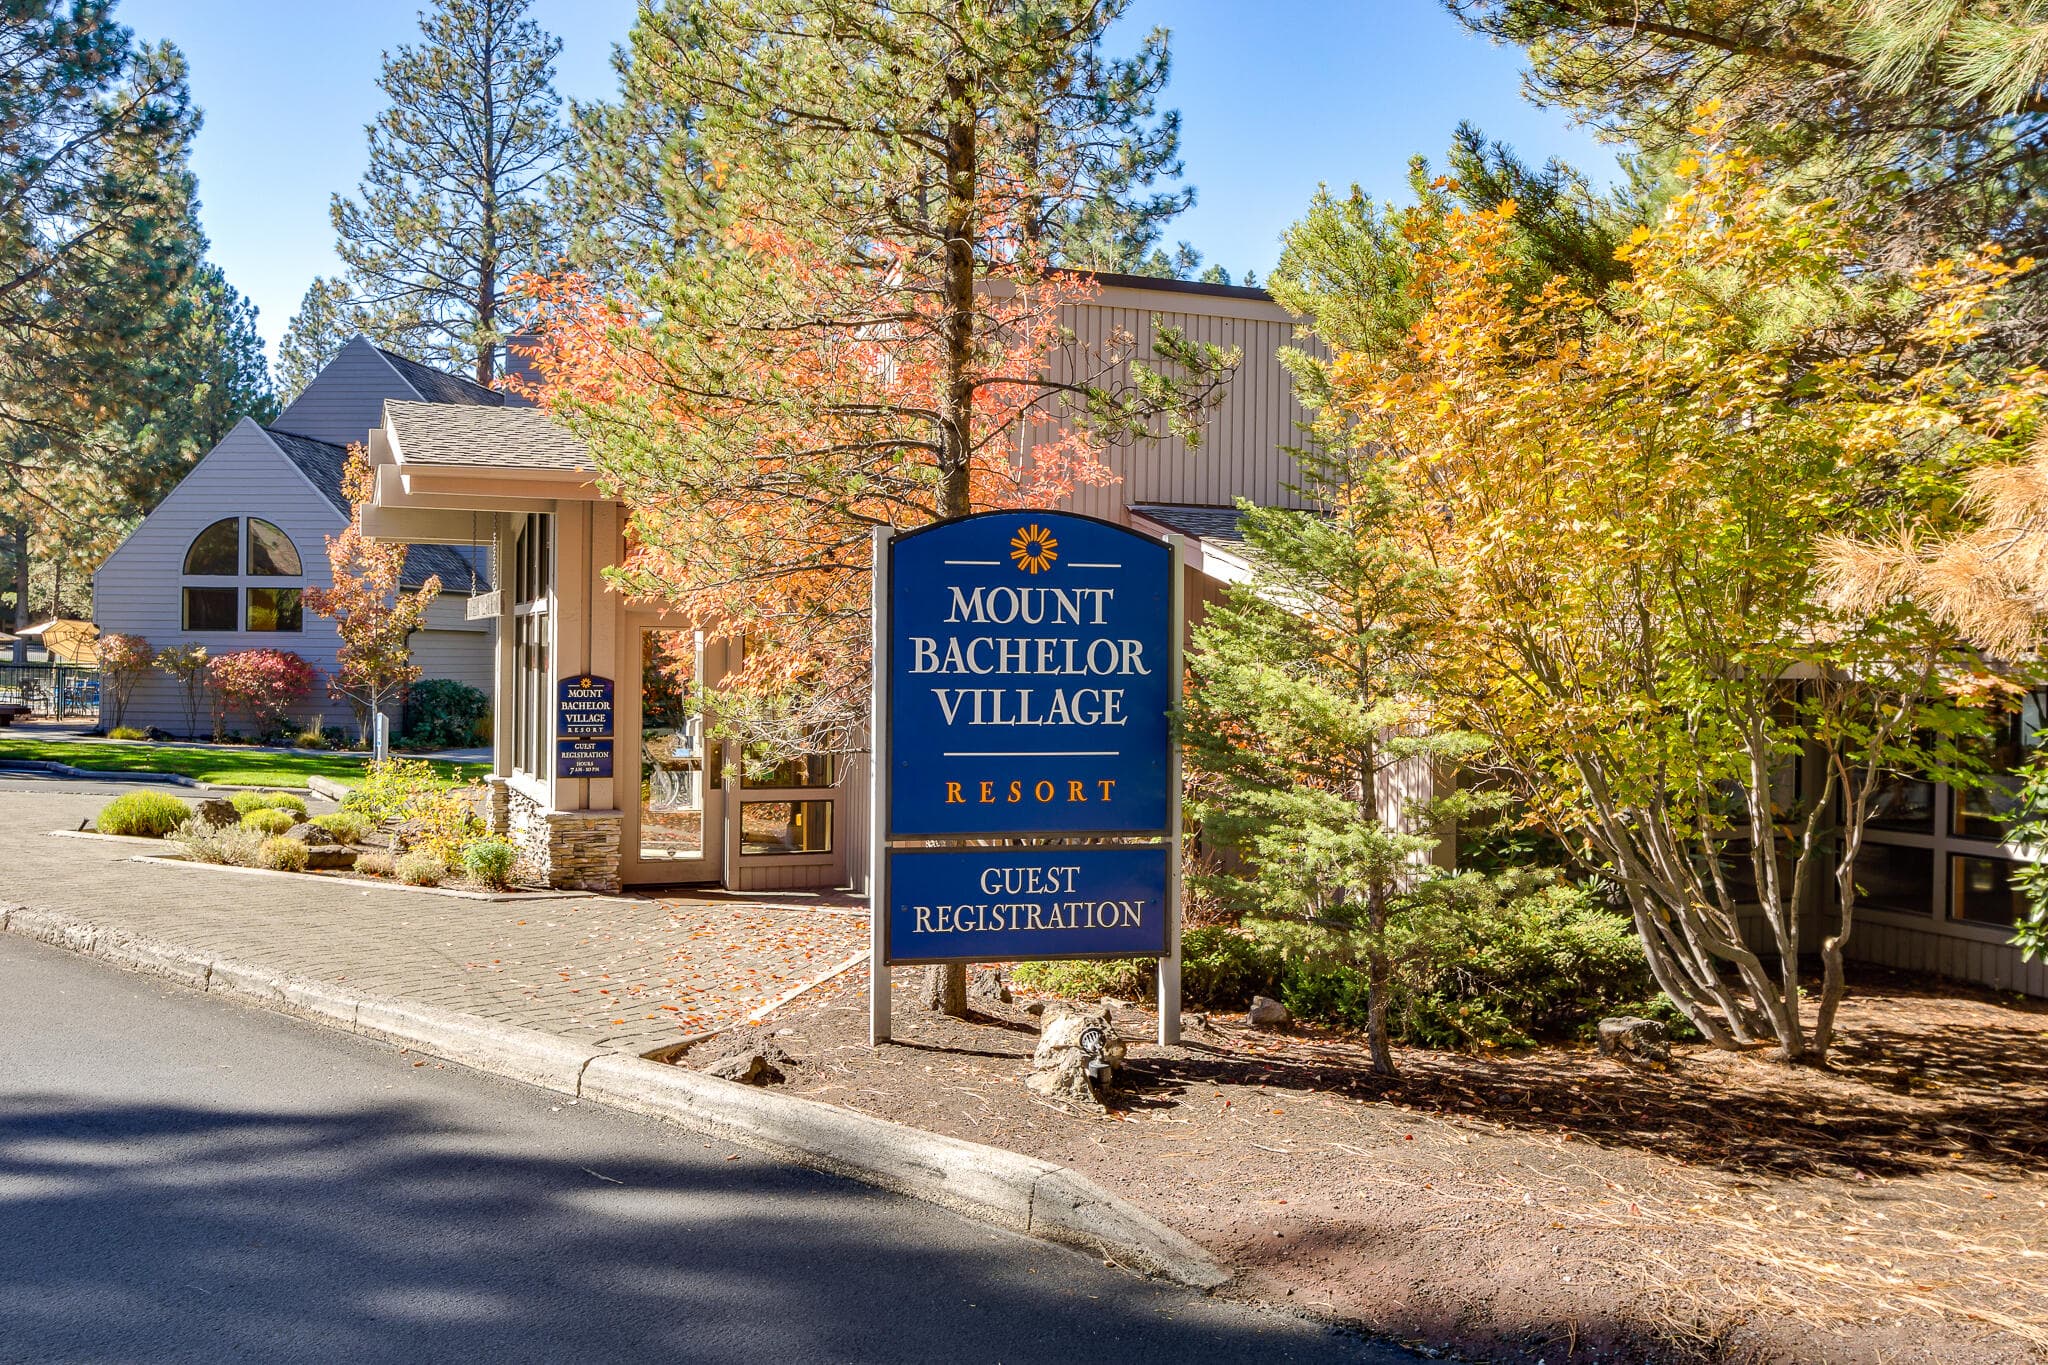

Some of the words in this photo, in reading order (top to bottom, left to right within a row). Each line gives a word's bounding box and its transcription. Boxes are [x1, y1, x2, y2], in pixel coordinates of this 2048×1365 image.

[943, 586, 1115, 626] MOUNT
[908, 637, 1152, 676] BACHELOR
[561, 701, 611, 710] BACHELOR
[567, 689, 603, 698] MOUNT
[565, 714, 606, 723] VILLAGE
[930, 688, 1128, 727] VILLAGE
[561, 751, 609, 759] REGISTRATION
[945, 780, 1116, 803] RESORT
[980, 866, 1081, 895] GUEST
[912, 900, 1145, 934] REGISTRATION
